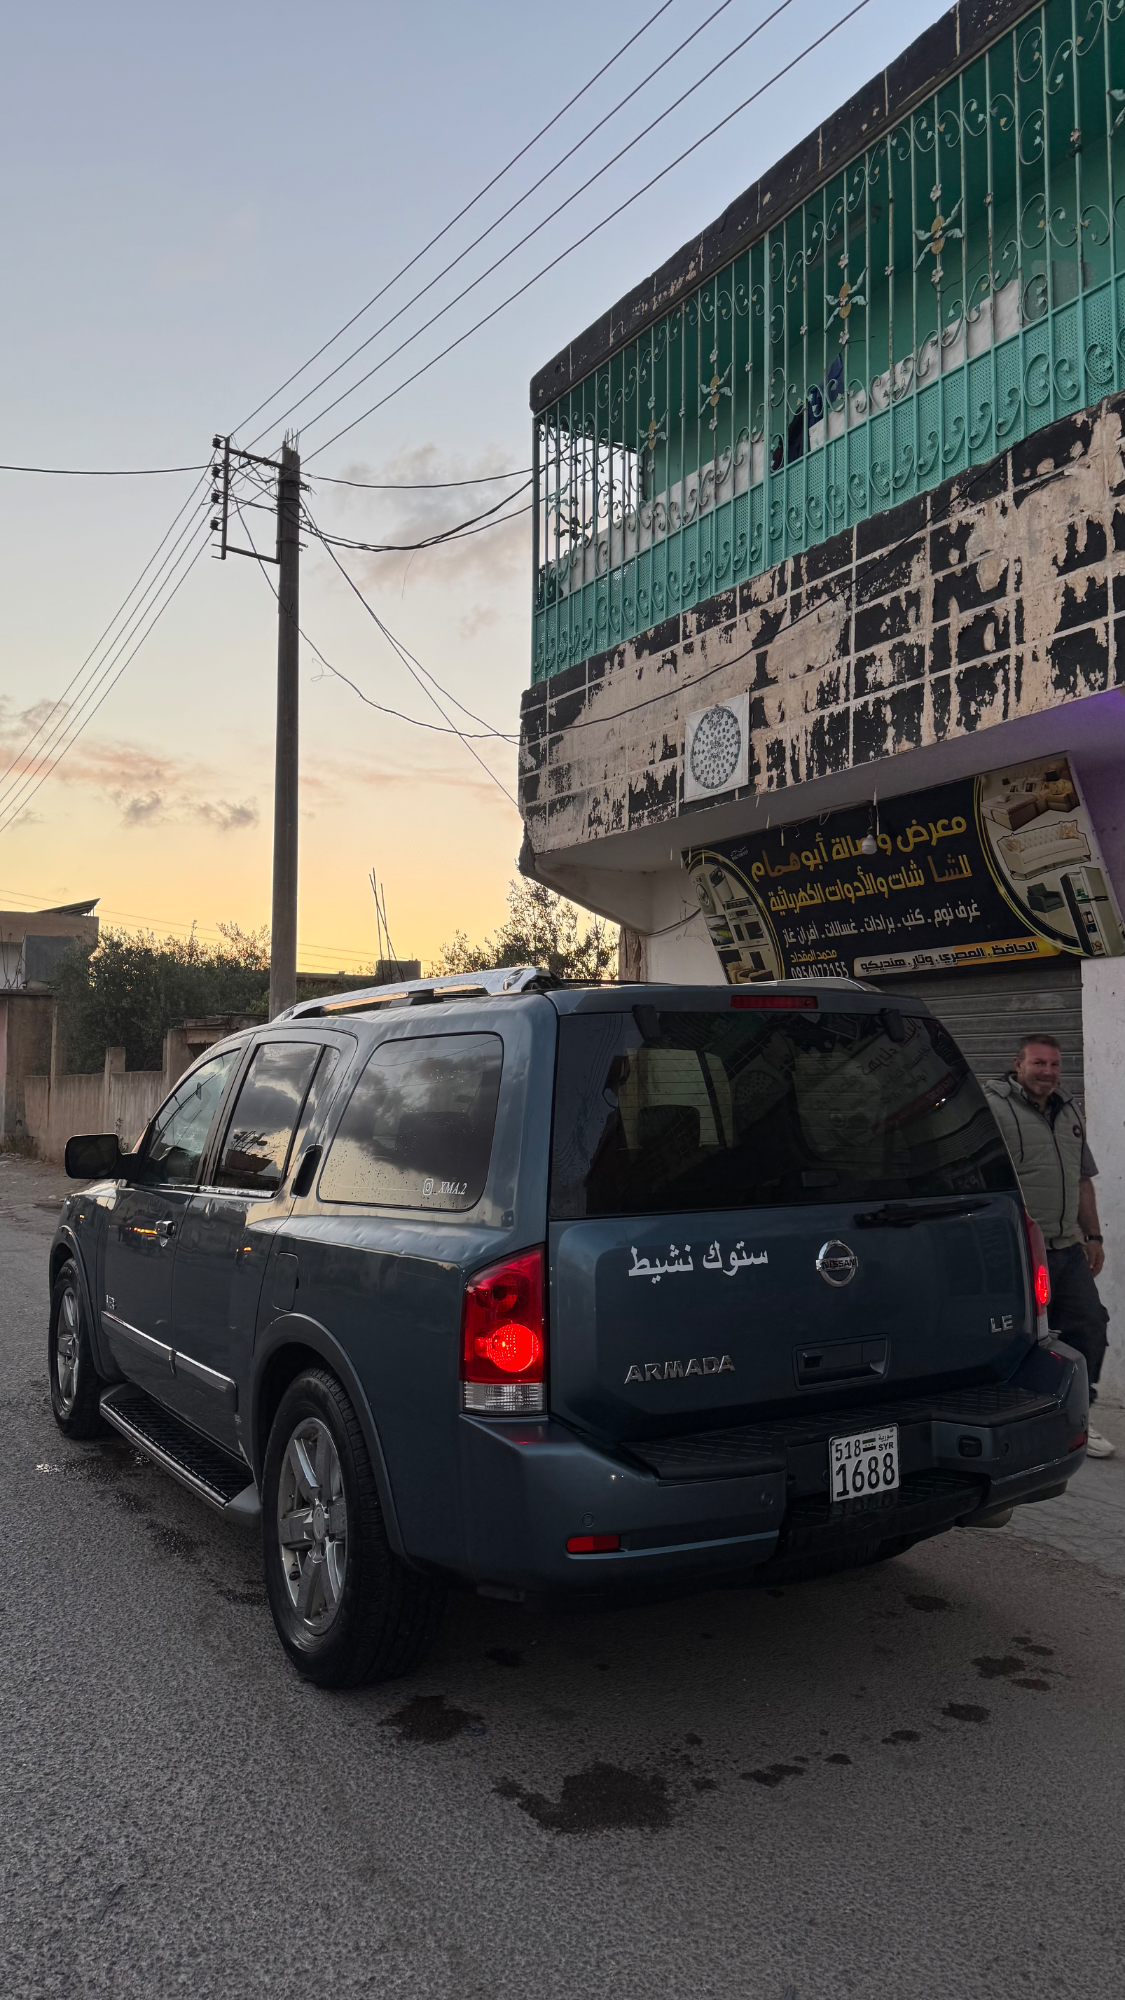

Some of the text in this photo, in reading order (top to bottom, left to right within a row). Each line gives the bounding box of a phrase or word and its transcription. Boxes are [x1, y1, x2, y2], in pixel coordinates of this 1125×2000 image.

[896, 816, 967, 852] معرض
[825, 866, 889, 904] والأدوات
[768, 882, 826, 915] الكهربائية
[955, 899, 981, 923] غرف
[934, 903, 954, 928] نوم
[782, 928, 797, 948] غاز
[797, 920, 819, 945] أفران
[790, 949, 837, 962] محمد المقداد
[628, 1240, 768, 1284] ستوك نشيط
[821, 1258, 856, 1269] NISSAN
[990, 1314, 1013, 1333] LE
[624, 1354, 735, 1384] ARMADA
[835, 1439, 861, 1462] 518
[878, 1441, 894, 1452] SYR
[835, 1452, 895, 1498] 1688
